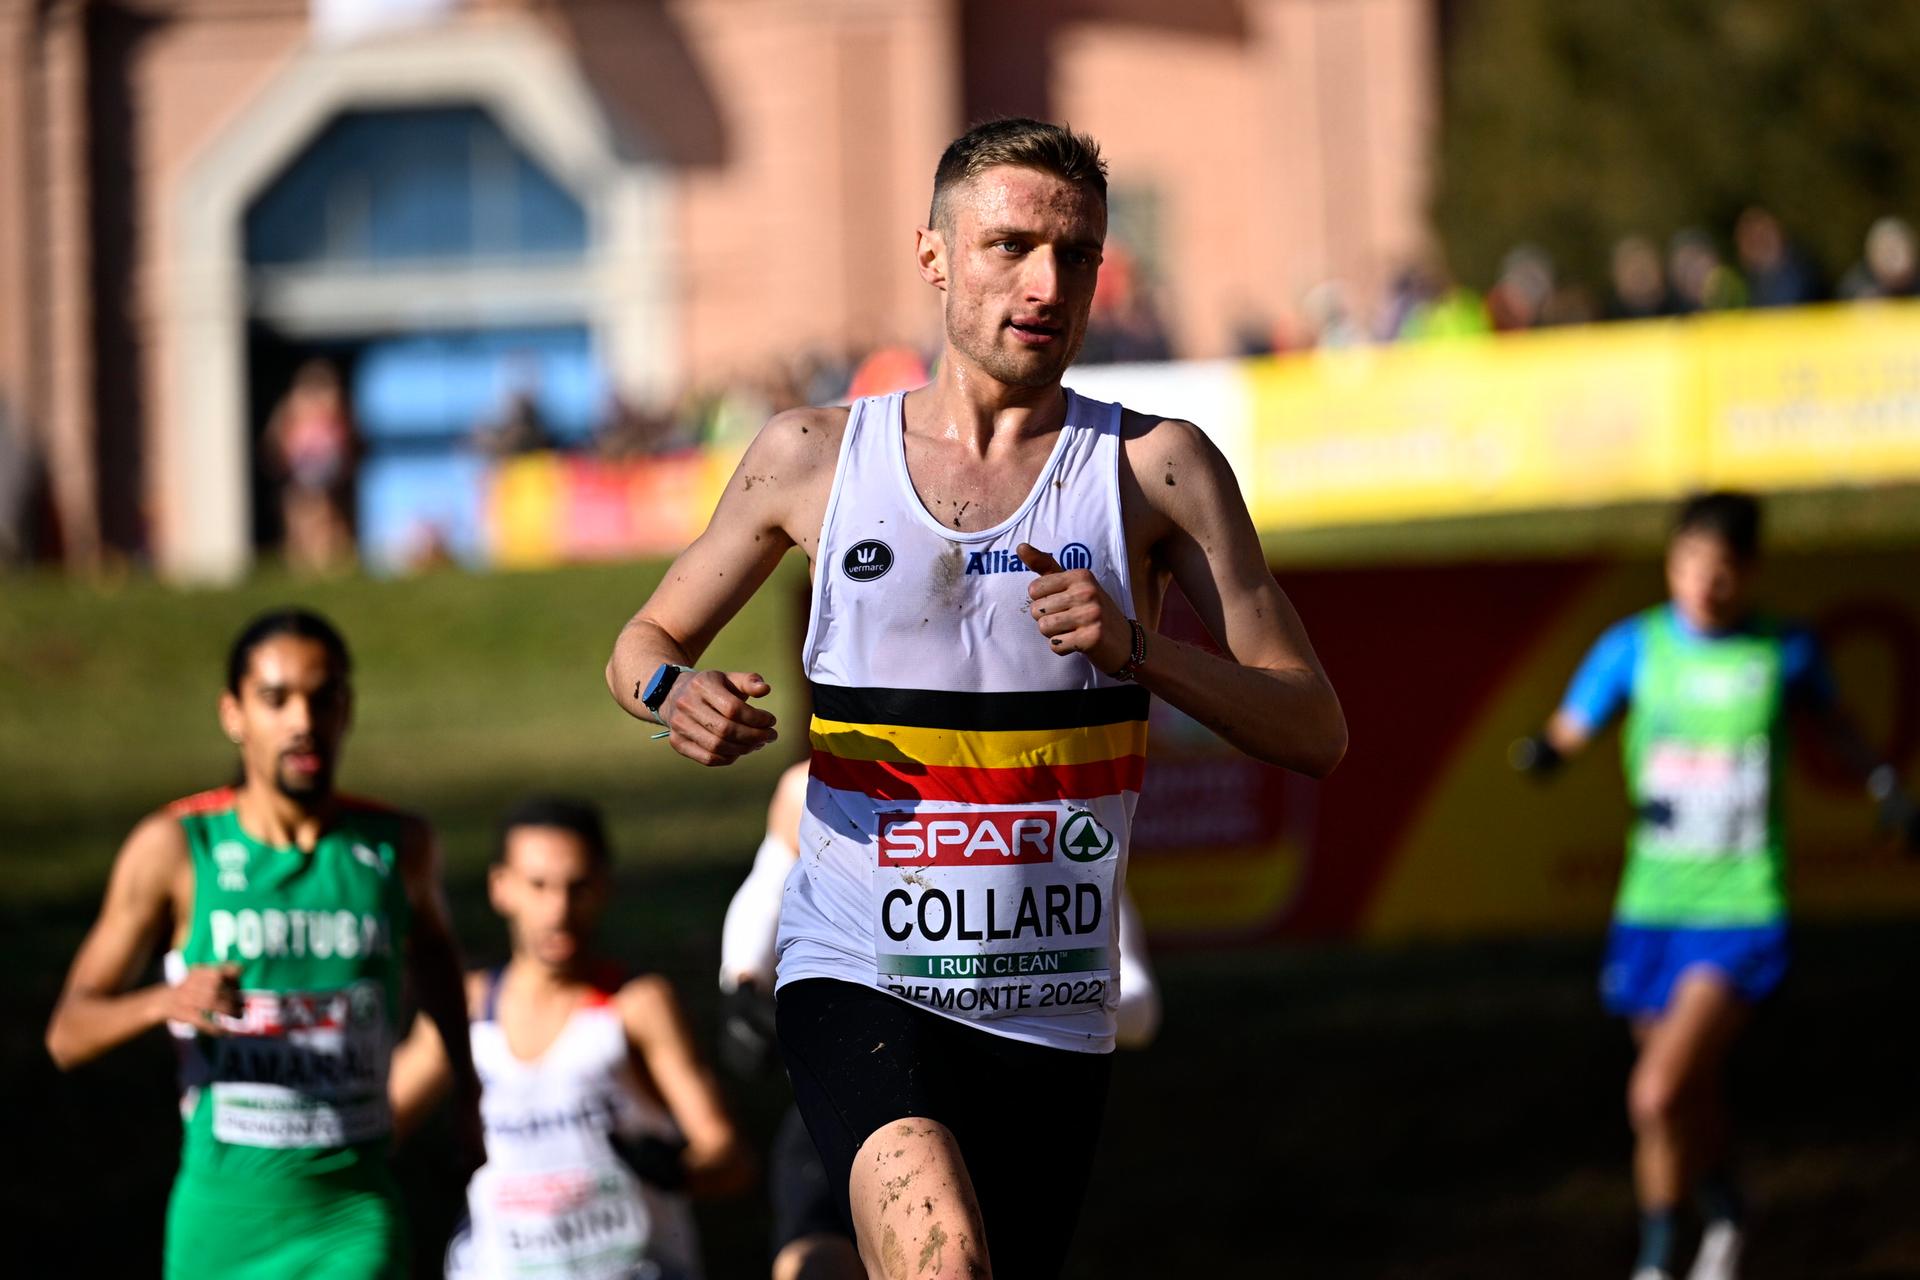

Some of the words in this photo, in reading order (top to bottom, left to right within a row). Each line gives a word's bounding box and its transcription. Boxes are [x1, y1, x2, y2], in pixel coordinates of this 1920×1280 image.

[848, 563, 885, 573] vermarc
[965, 549, 1053, 575] Allia
[883, 818, 1051, 859] SPAR
[881, 882, 1103, 942] COLLARD
[928, 958, 933, 975] I
[940, 956, 987, 976] RUN
[1038, 979, 1103, 1008] 2022
